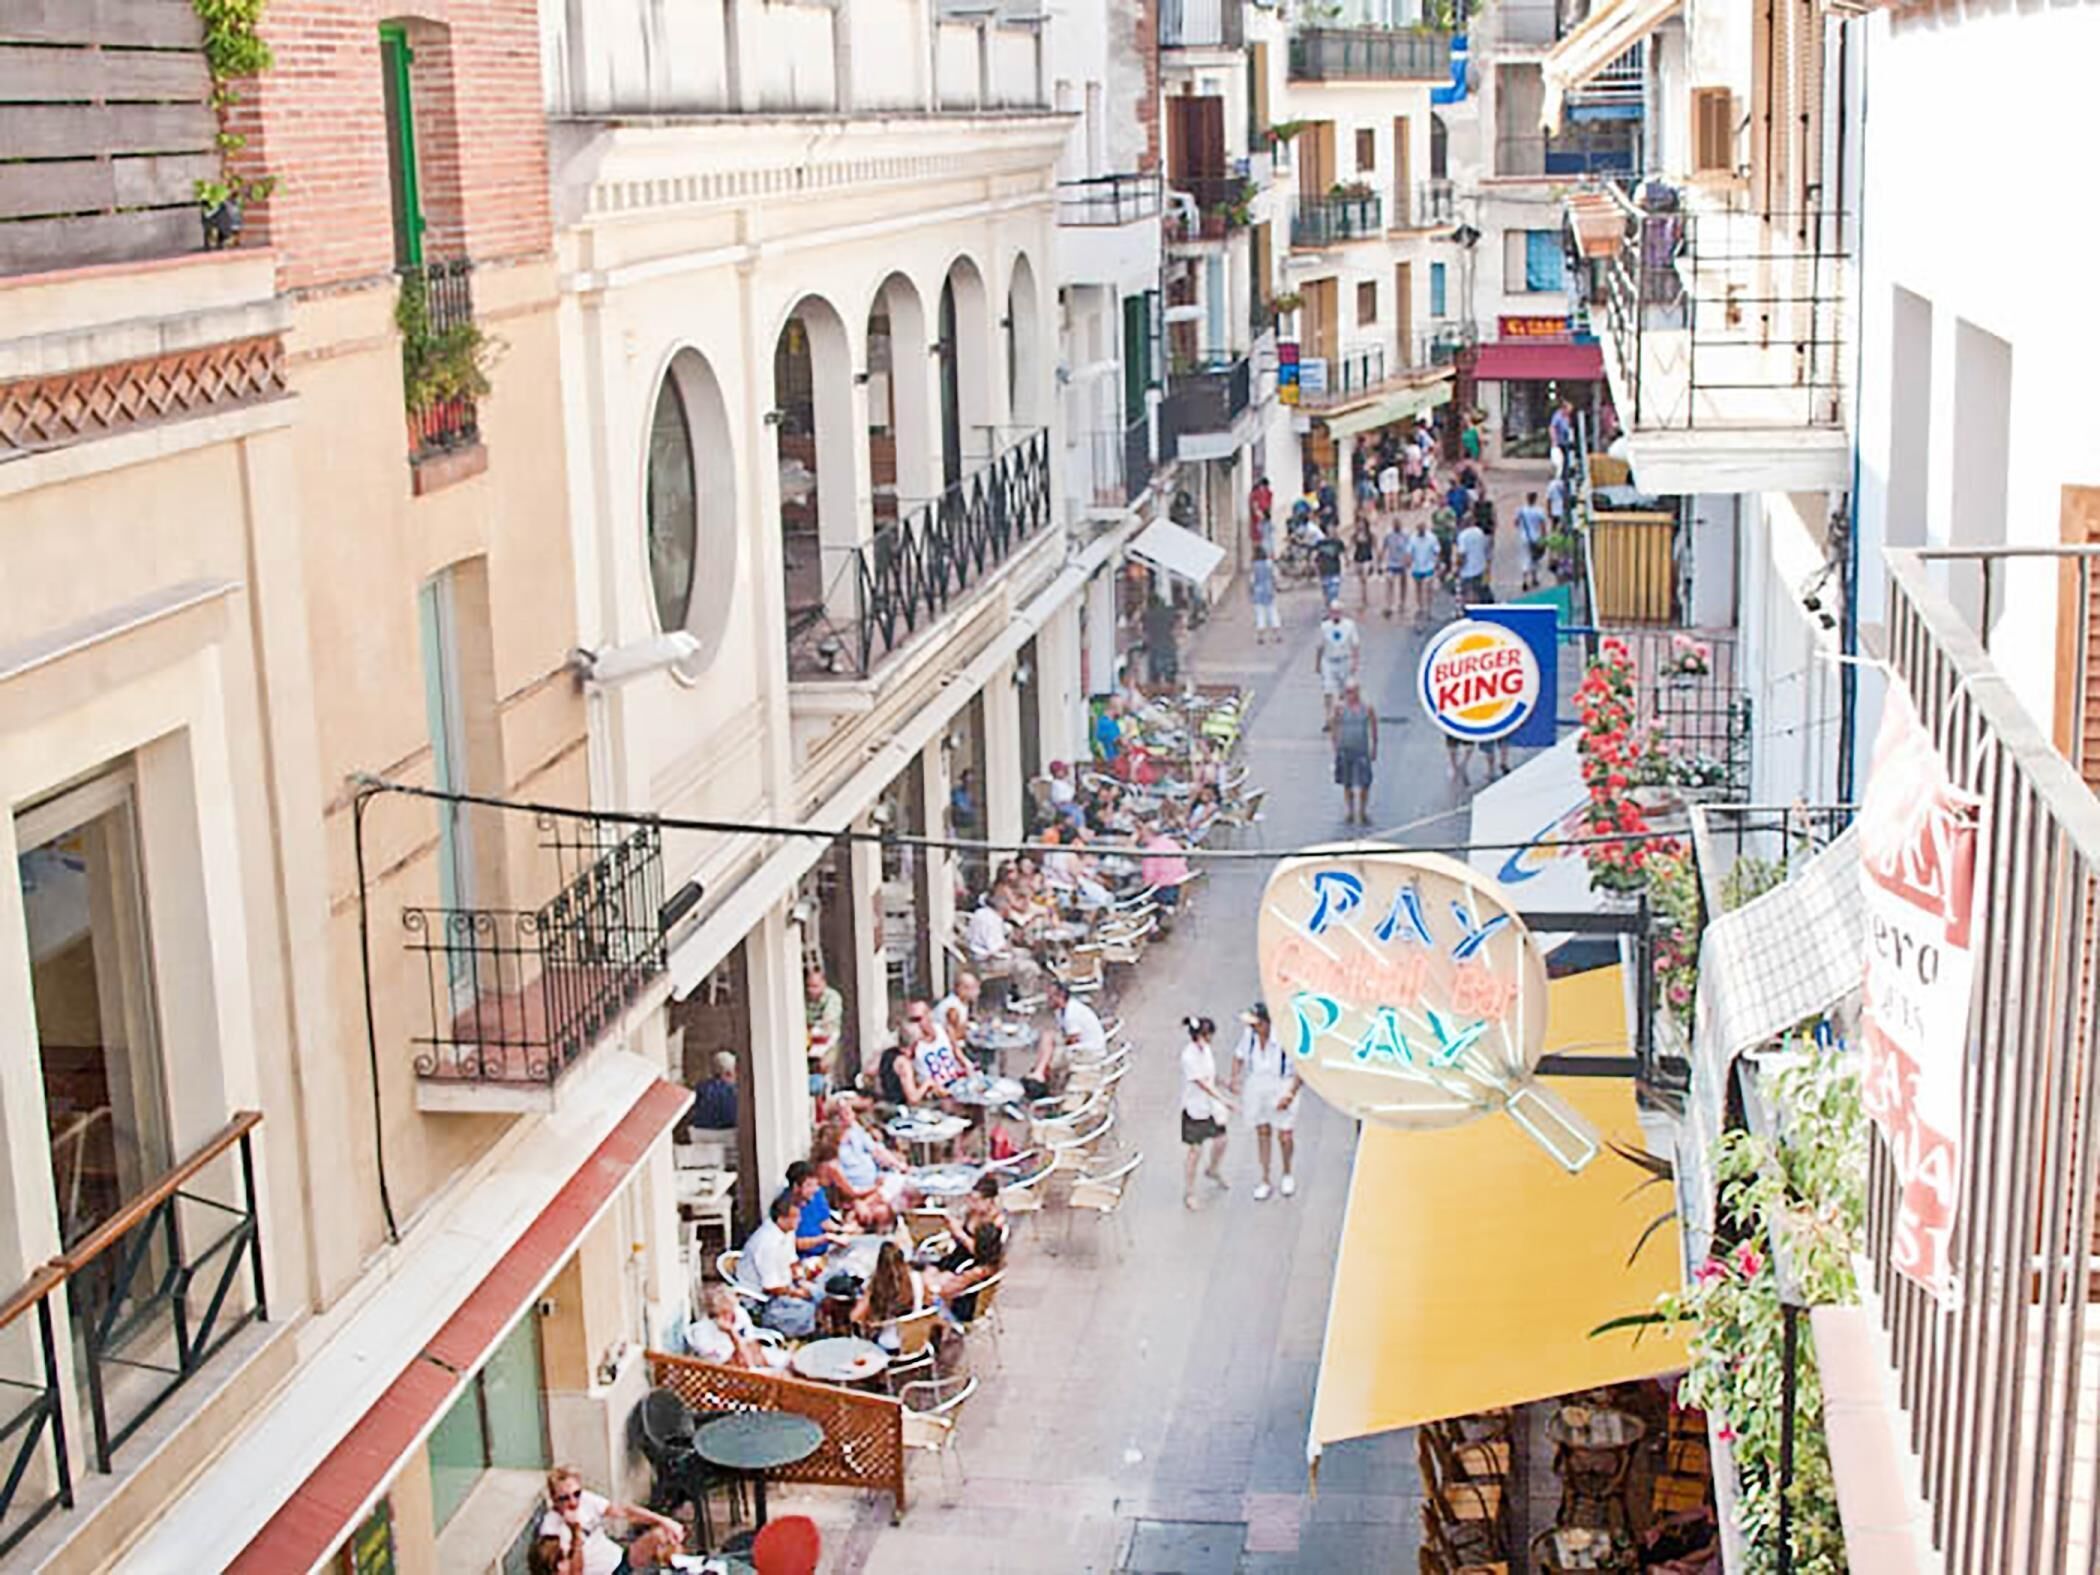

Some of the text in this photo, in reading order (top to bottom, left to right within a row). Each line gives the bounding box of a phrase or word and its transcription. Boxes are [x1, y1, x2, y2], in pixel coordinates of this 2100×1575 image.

[1435, 649, 1522, 683] BURGER
[1438, 668, 1524, 711] KING
[1308, 872, 1509, 959] PAY
[1451, 964, 1518, 1018] Bar
[1292, 991, 1490, 1067] PAY
